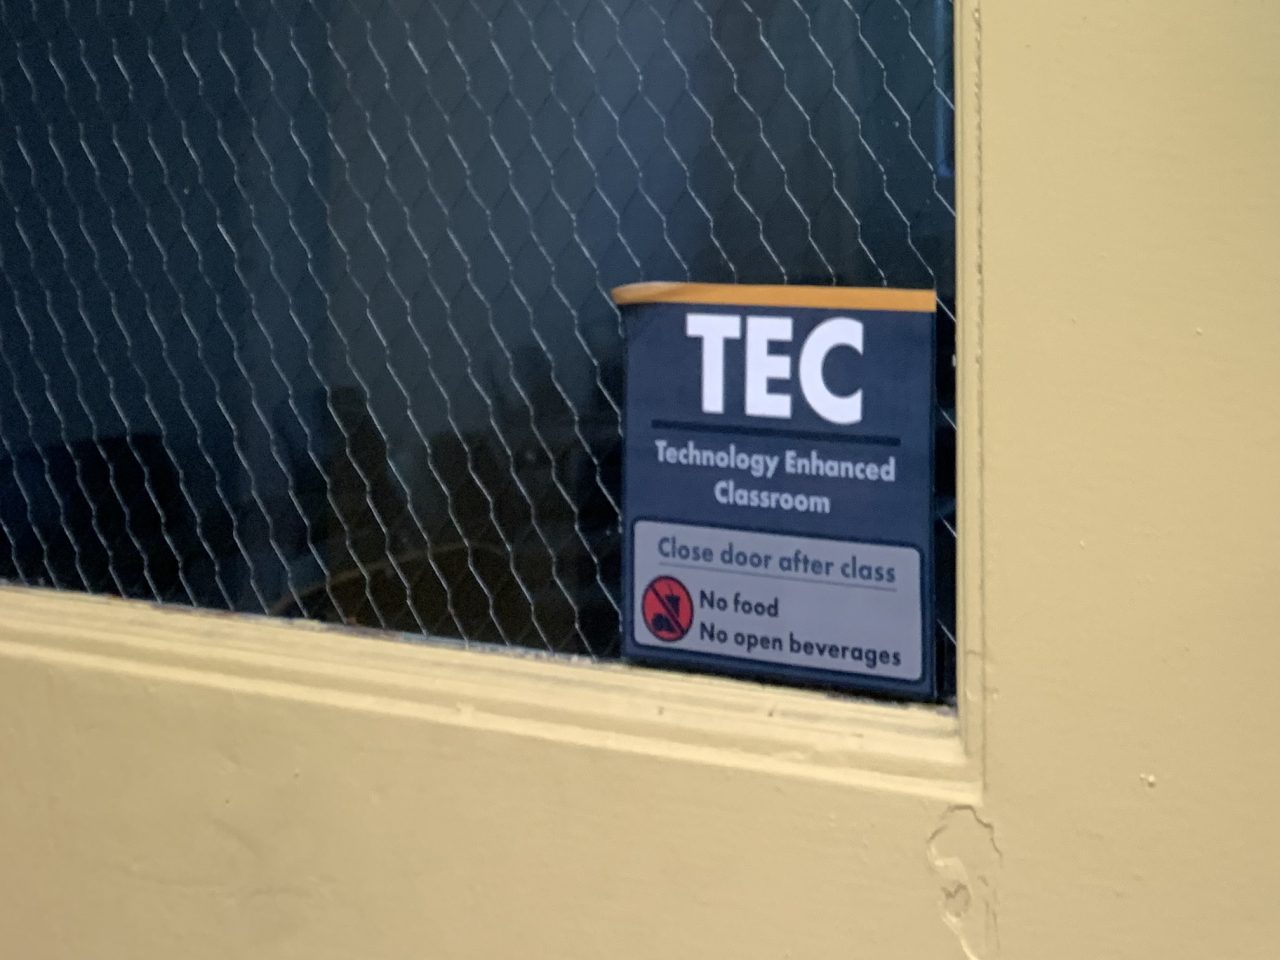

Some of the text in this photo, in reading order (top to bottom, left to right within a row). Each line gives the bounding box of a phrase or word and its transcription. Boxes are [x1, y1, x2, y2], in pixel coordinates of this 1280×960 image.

[686, 312, 864, 425] TEC
[655, 440, 896, 482] Technology Enhanced
[713, 481, 831, 513] Classroom
[657, 536, 896, 583] Close door after class
[699, 590, 779, 618] No food
[699, 622, 902, 669] No open beverages
